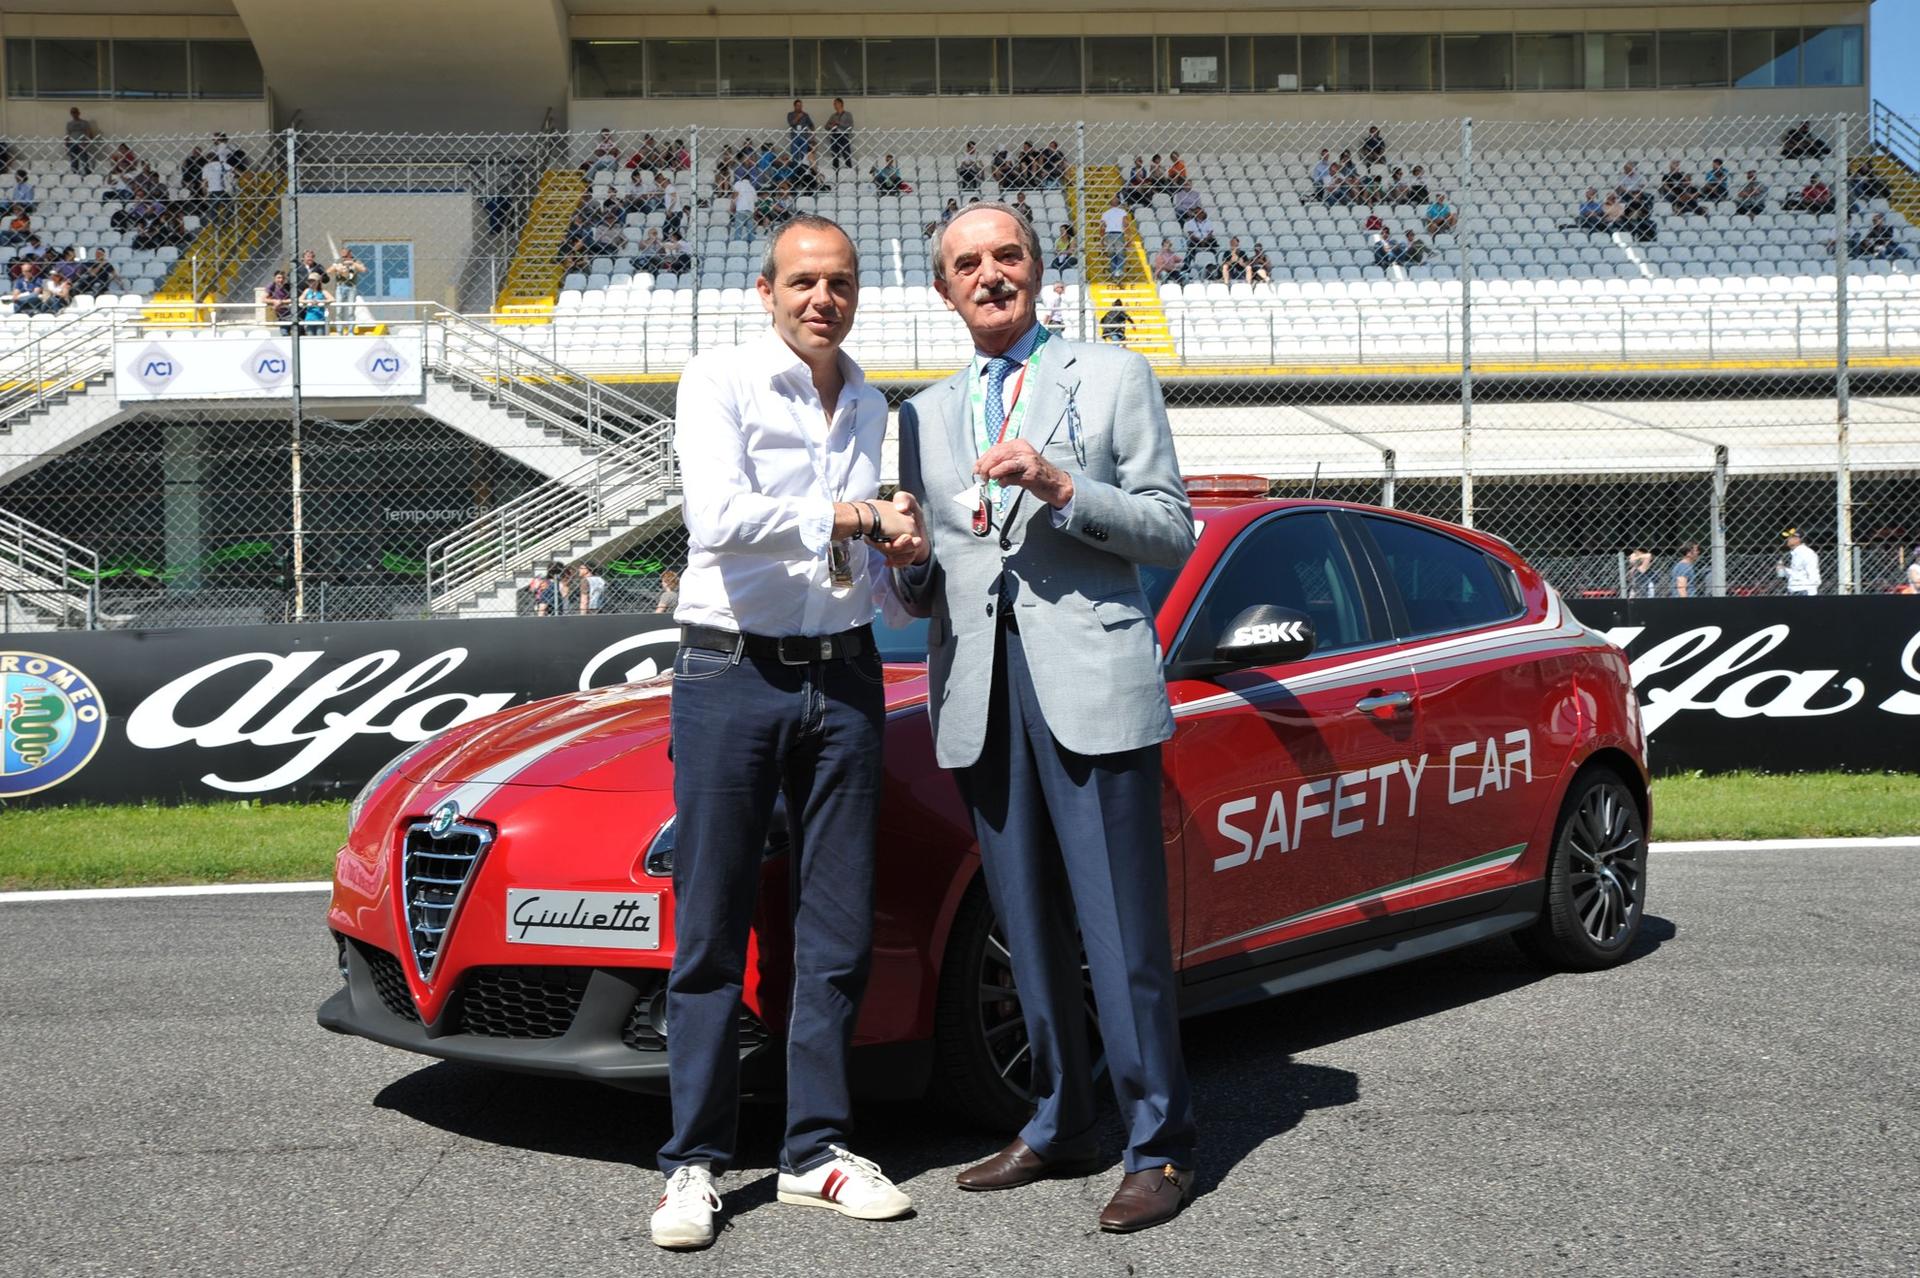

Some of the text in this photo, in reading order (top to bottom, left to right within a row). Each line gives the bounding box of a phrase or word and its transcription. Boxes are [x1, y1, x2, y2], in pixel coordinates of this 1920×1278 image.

[144, 361, 173, 376] ACI
[258, 359, 286, 374] ACI
[371, 358, 400, 372] ACI
[383, 507, 464, 524] Temporary
[0, 656, 99, 723] ROMEO
[1213, 728, 1532, 872] SAFETY CAR
[513, 896, 651, 939] Giulietta
